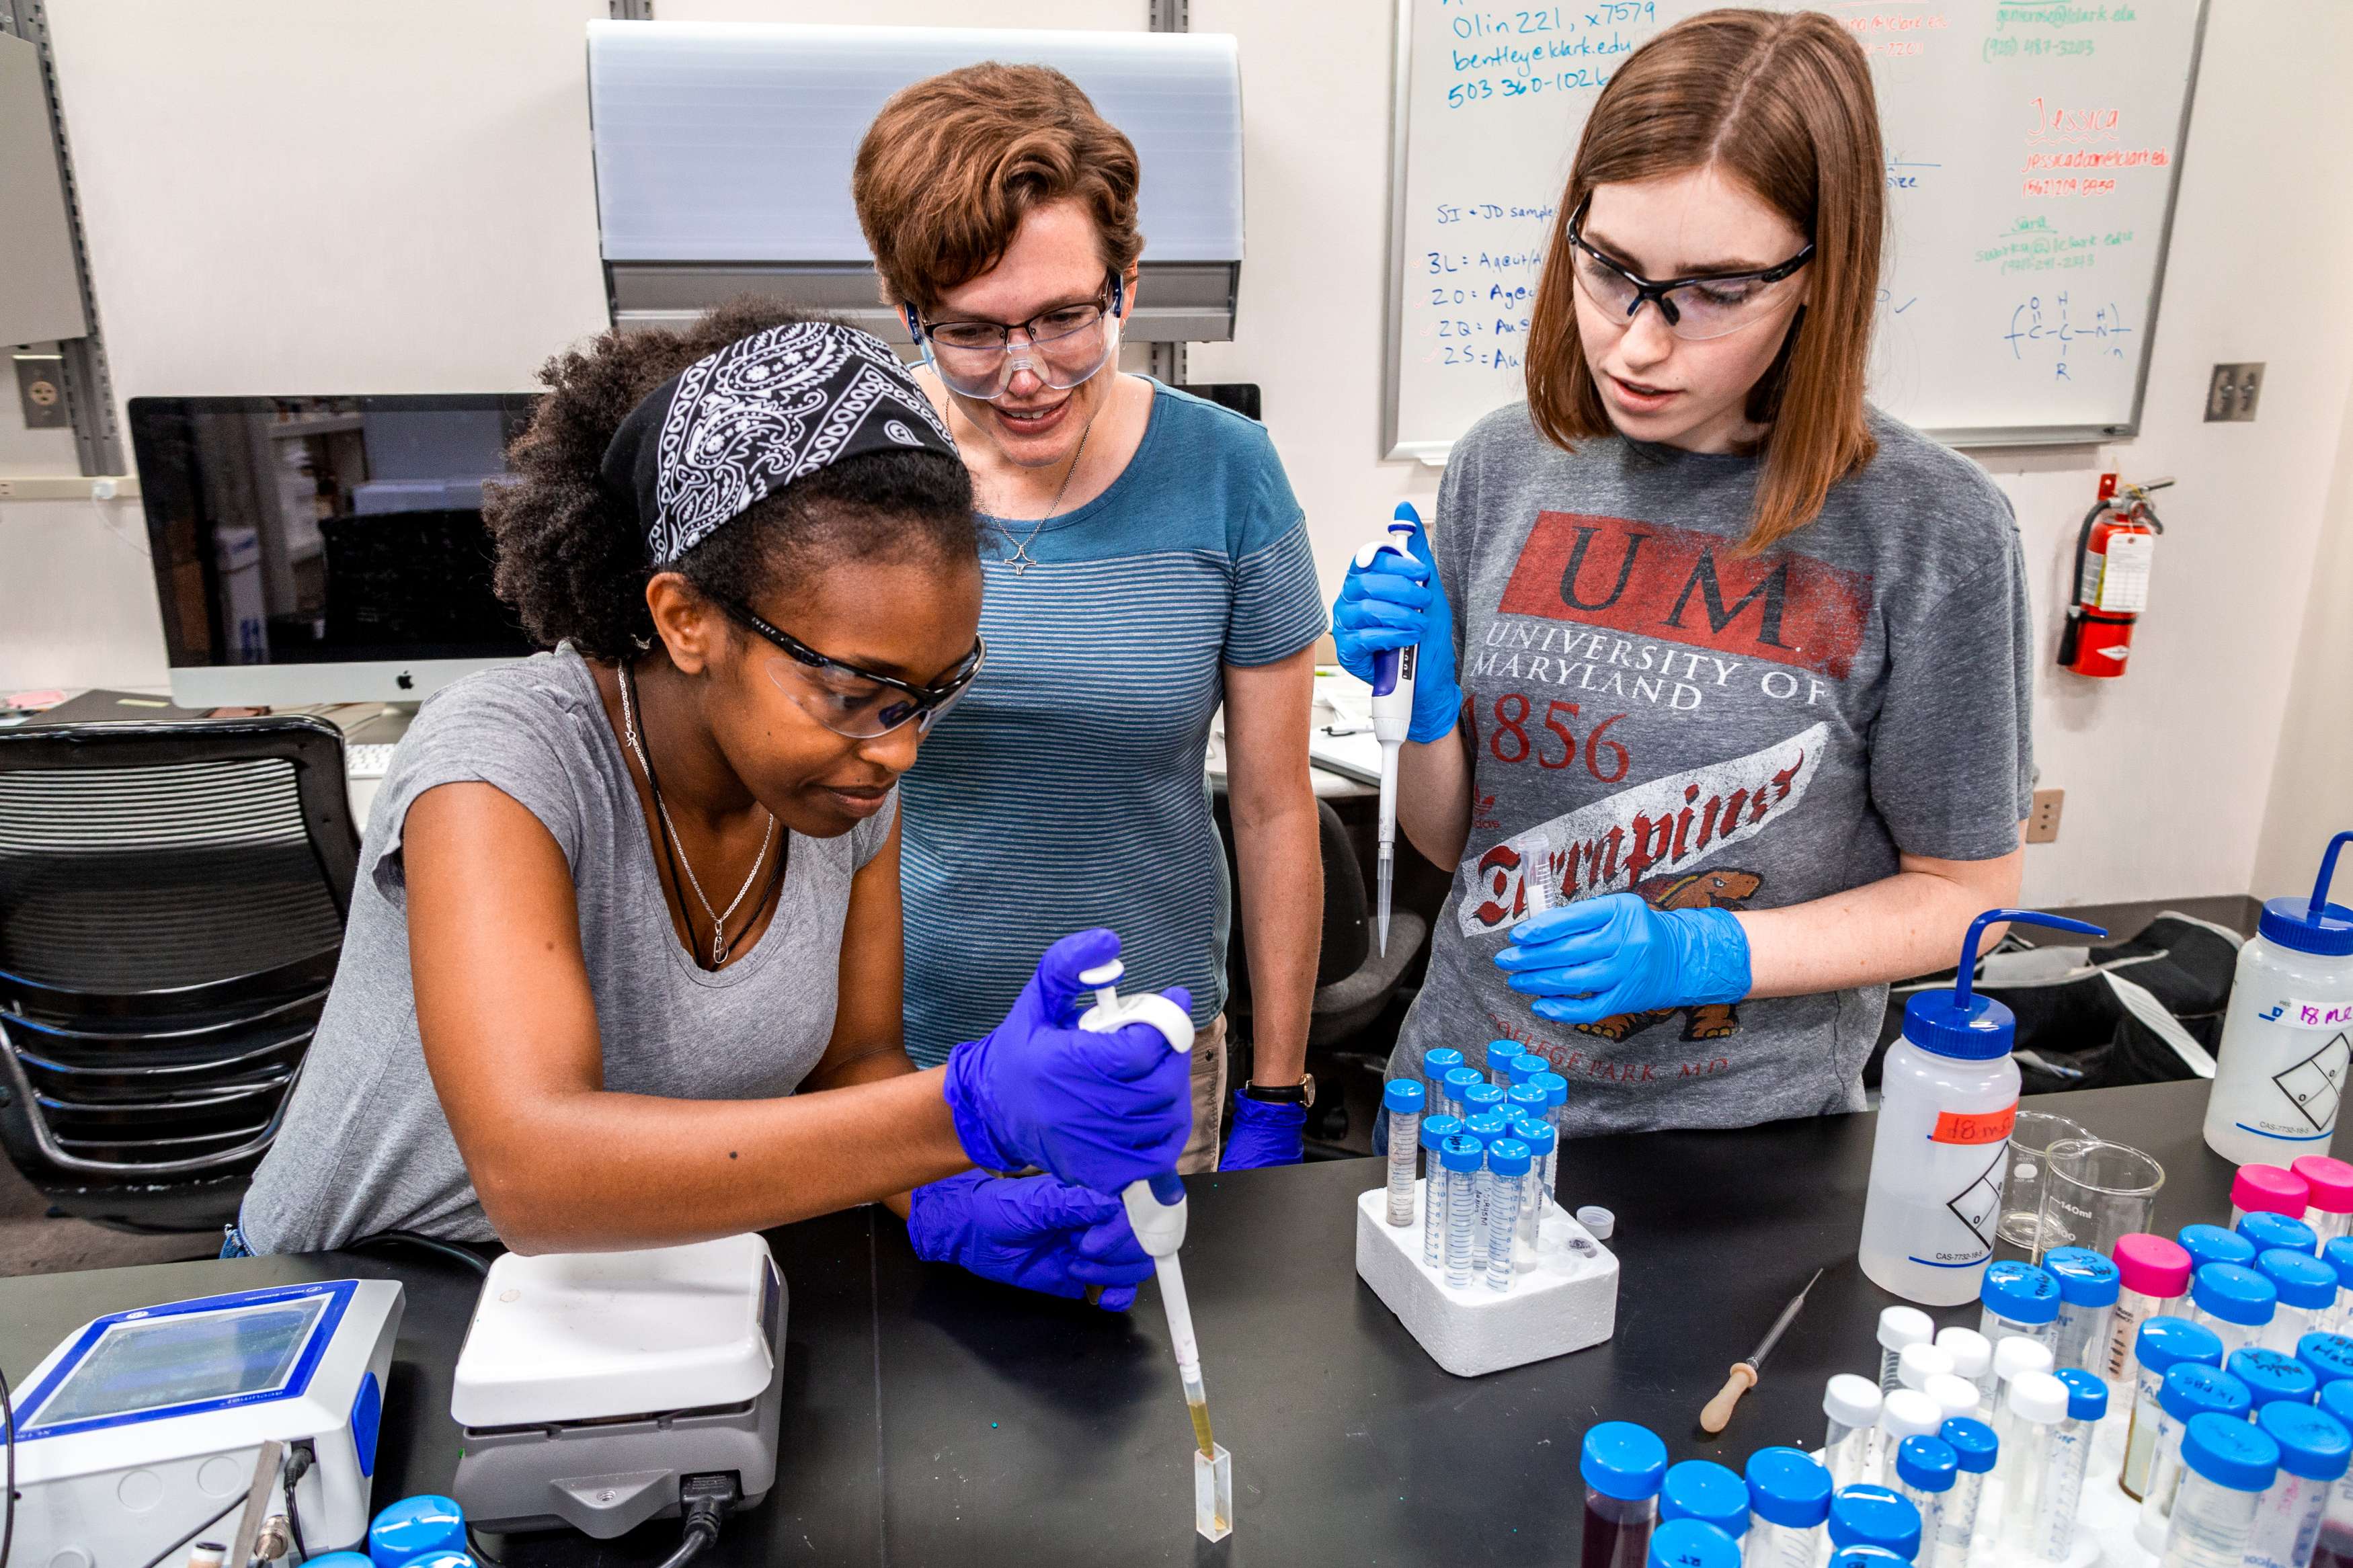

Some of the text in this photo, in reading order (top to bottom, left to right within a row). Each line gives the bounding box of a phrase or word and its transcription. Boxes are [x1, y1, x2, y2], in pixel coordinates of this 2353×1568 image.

[1453, 13, 1509, 39] Olin
[1449, 79, 1493, 109] 503
[2026, 97, 2119, 134] Jessica
[1484, 621, 1830, 706] UNIVERSITY OF
[1469, 650, 1703, 711] MARYLAND
[1462, 692, 1630, 784] 1856
[1588, 1059, 1658, 1084] PARK
[2061, 1200, 2093, 1220] 140ml
